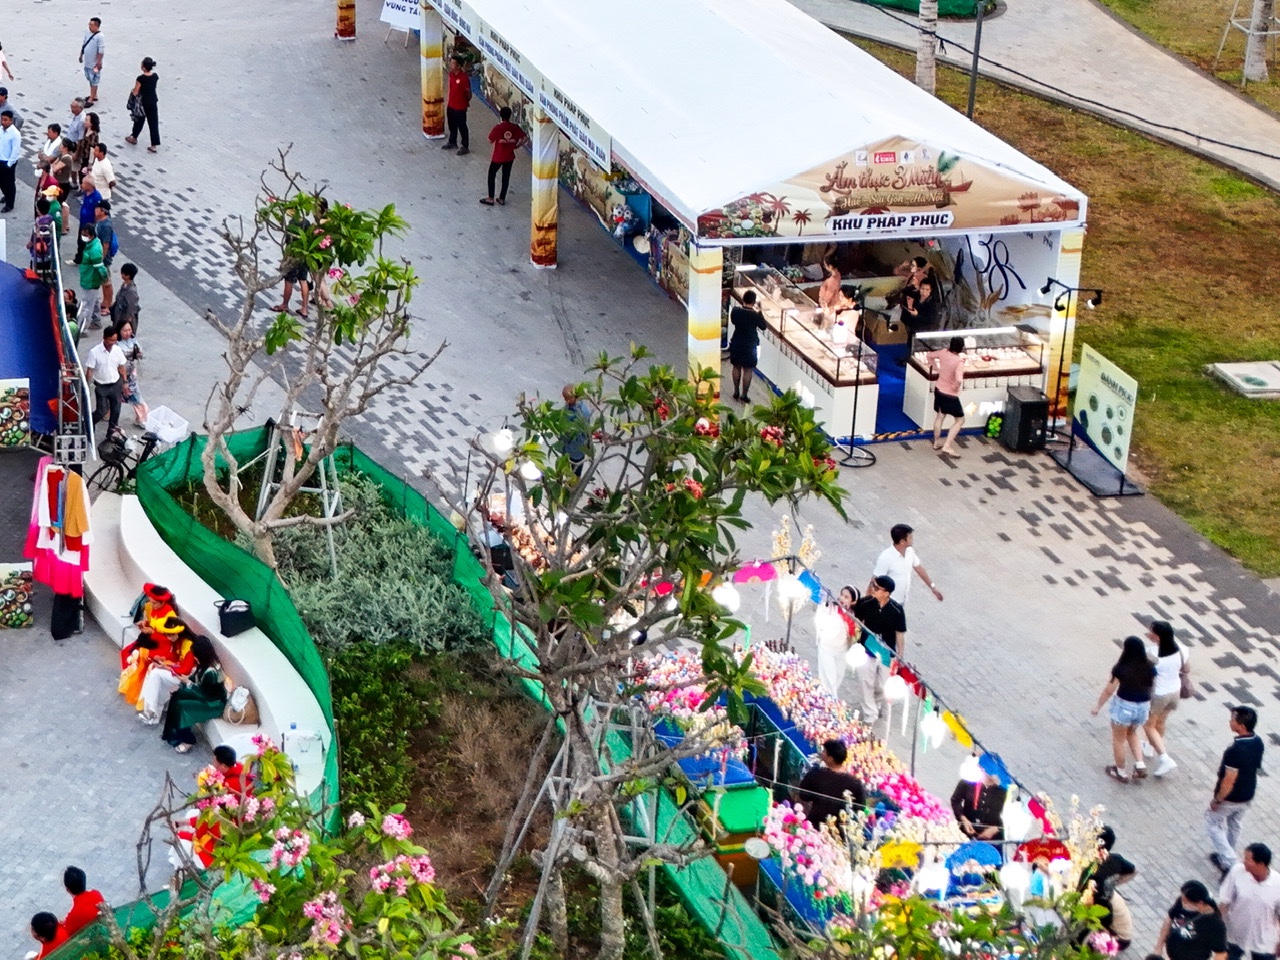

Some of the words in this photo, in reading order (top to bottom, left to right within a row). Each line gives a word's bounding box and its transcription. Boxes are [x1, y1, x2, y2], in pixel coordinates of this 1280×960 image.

[892, 165, 907, 189] 3
[832, 217, 863, 231] KHU
[866, 214, 907, 229] PHÁP
